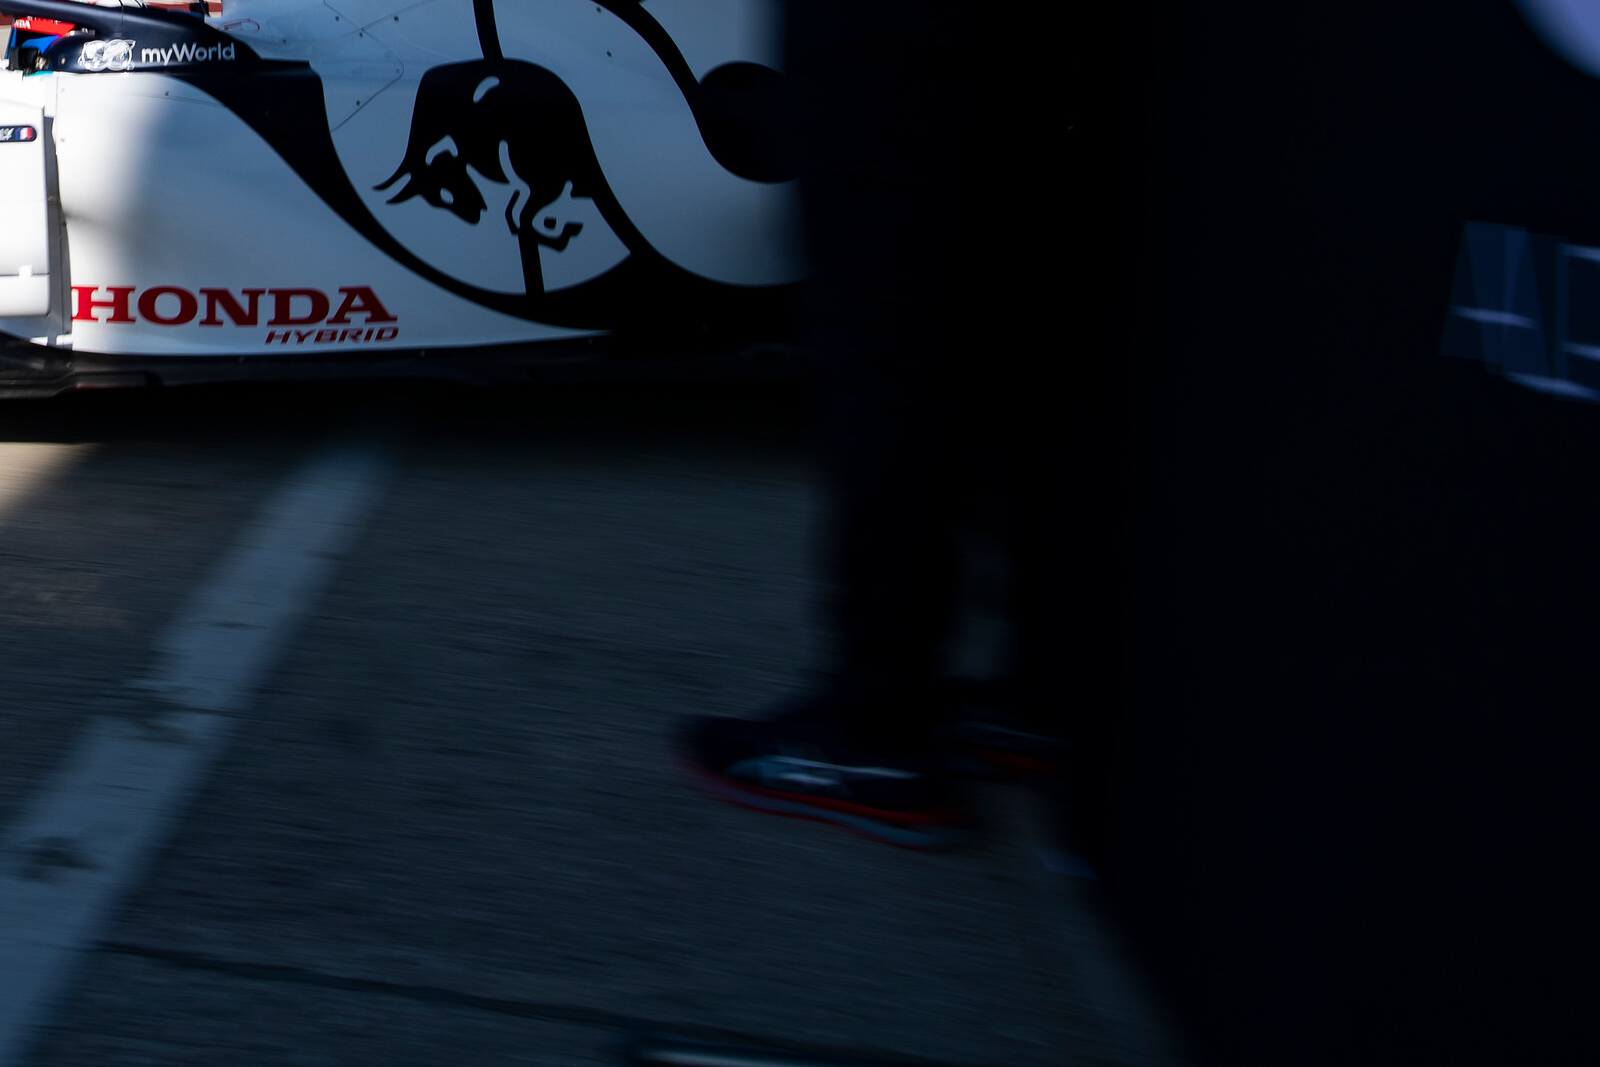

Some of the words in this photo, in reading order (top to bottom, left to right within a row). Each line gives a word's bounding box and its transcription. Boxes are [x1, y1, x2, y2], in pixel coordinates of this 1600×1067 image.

[141, 42, 235, 66] myWorld
[71, 285, 398, 327] HONDA
[265, 327, 399, 345] HYBRID
